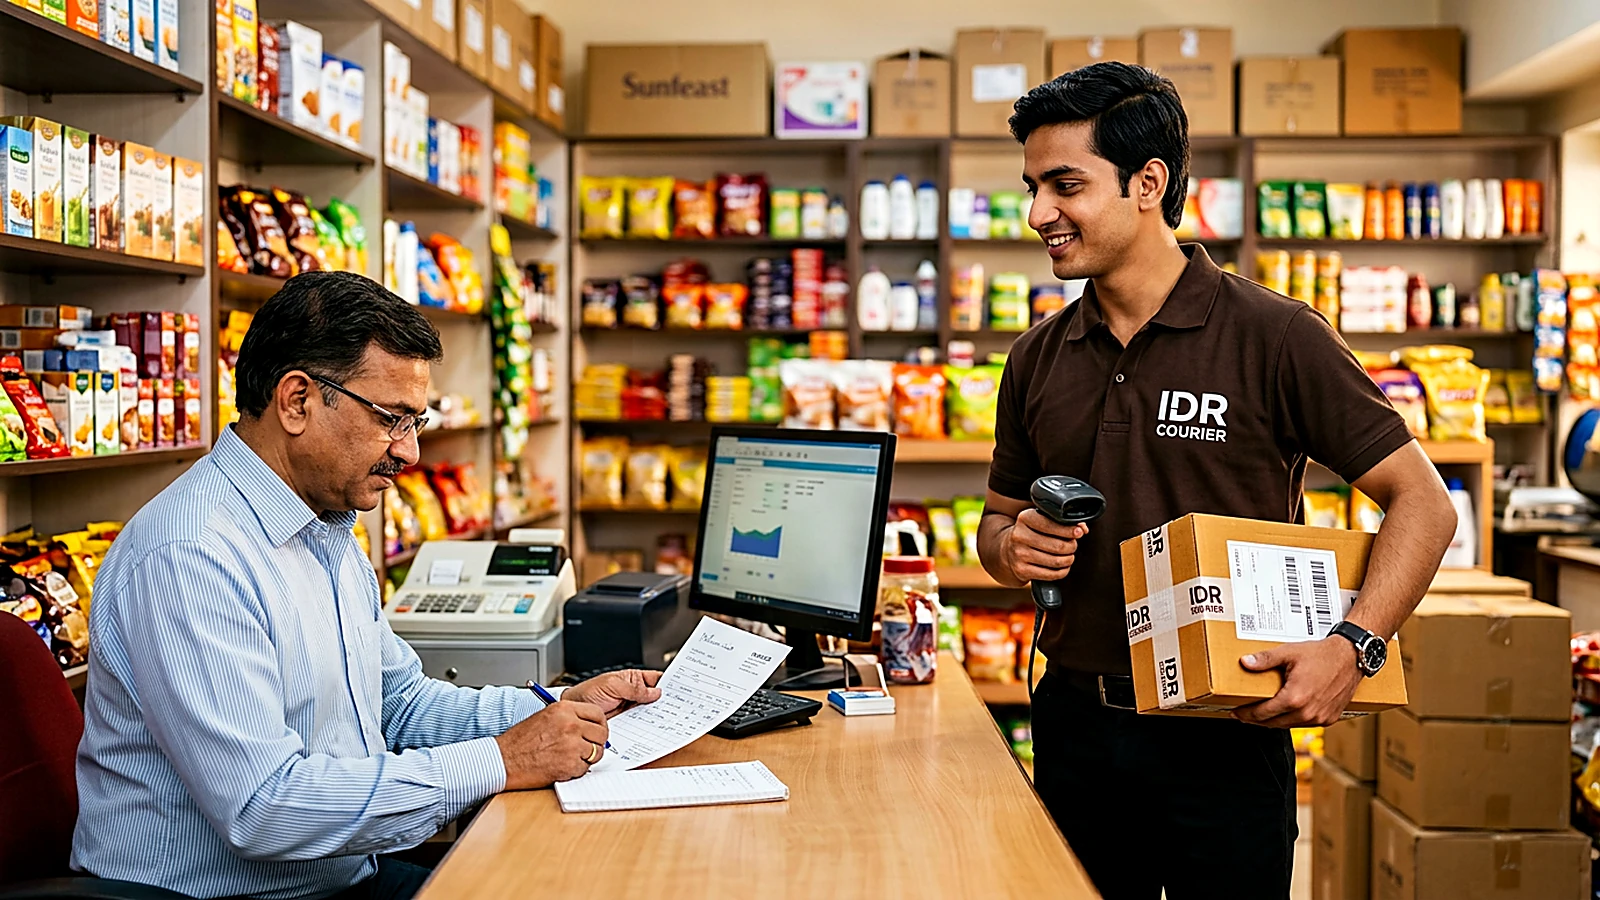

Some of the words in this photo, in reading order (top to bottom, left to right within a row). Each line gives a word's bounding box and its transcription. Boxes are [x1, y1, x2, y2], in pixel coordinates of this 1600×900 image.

[622, 71, 730, 99] Sunfeast
[1158, 390, 1228, 427] IDR
[1156, 423, 1227, 443] COURIER
[1189, 585, 1223, 606] IDR
[1127, 605, 1151, 630] IDR
[1165, 656, 1179, 697] IDR
